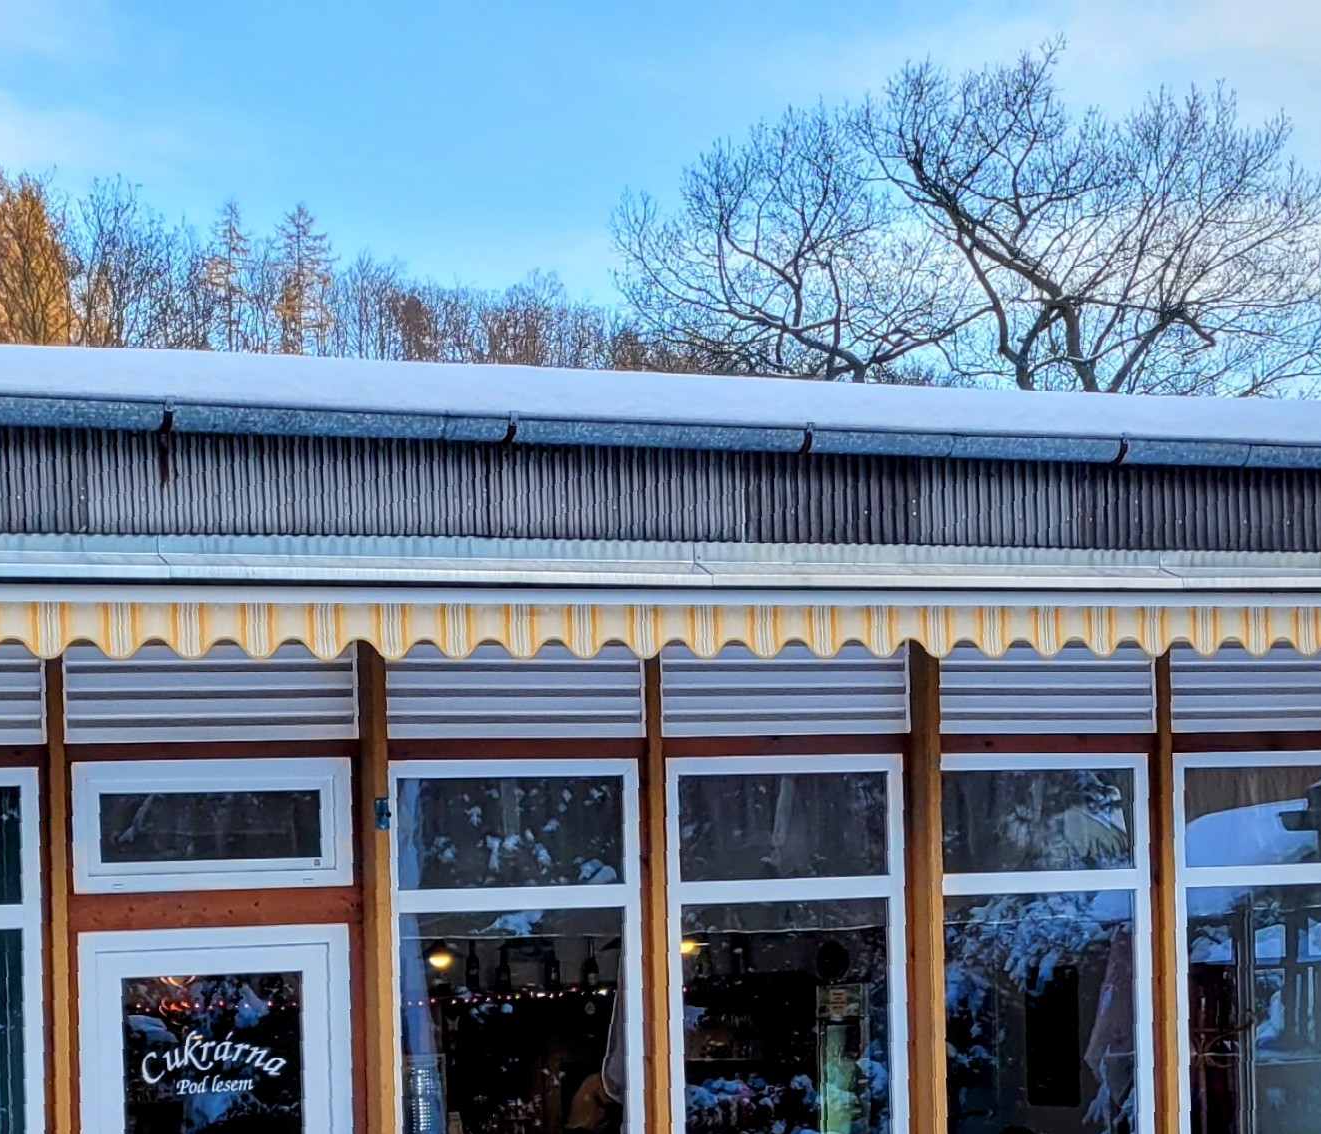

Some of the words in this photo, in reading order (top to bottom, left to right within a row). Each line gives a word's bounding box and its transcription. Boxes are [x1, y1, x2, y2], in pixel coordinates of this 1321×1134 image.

[141, 1031, 287, 1085] Cukrárna
[176, 1076, 210, 1095] Pod
[211, 1074, 255, 1093] lesem
